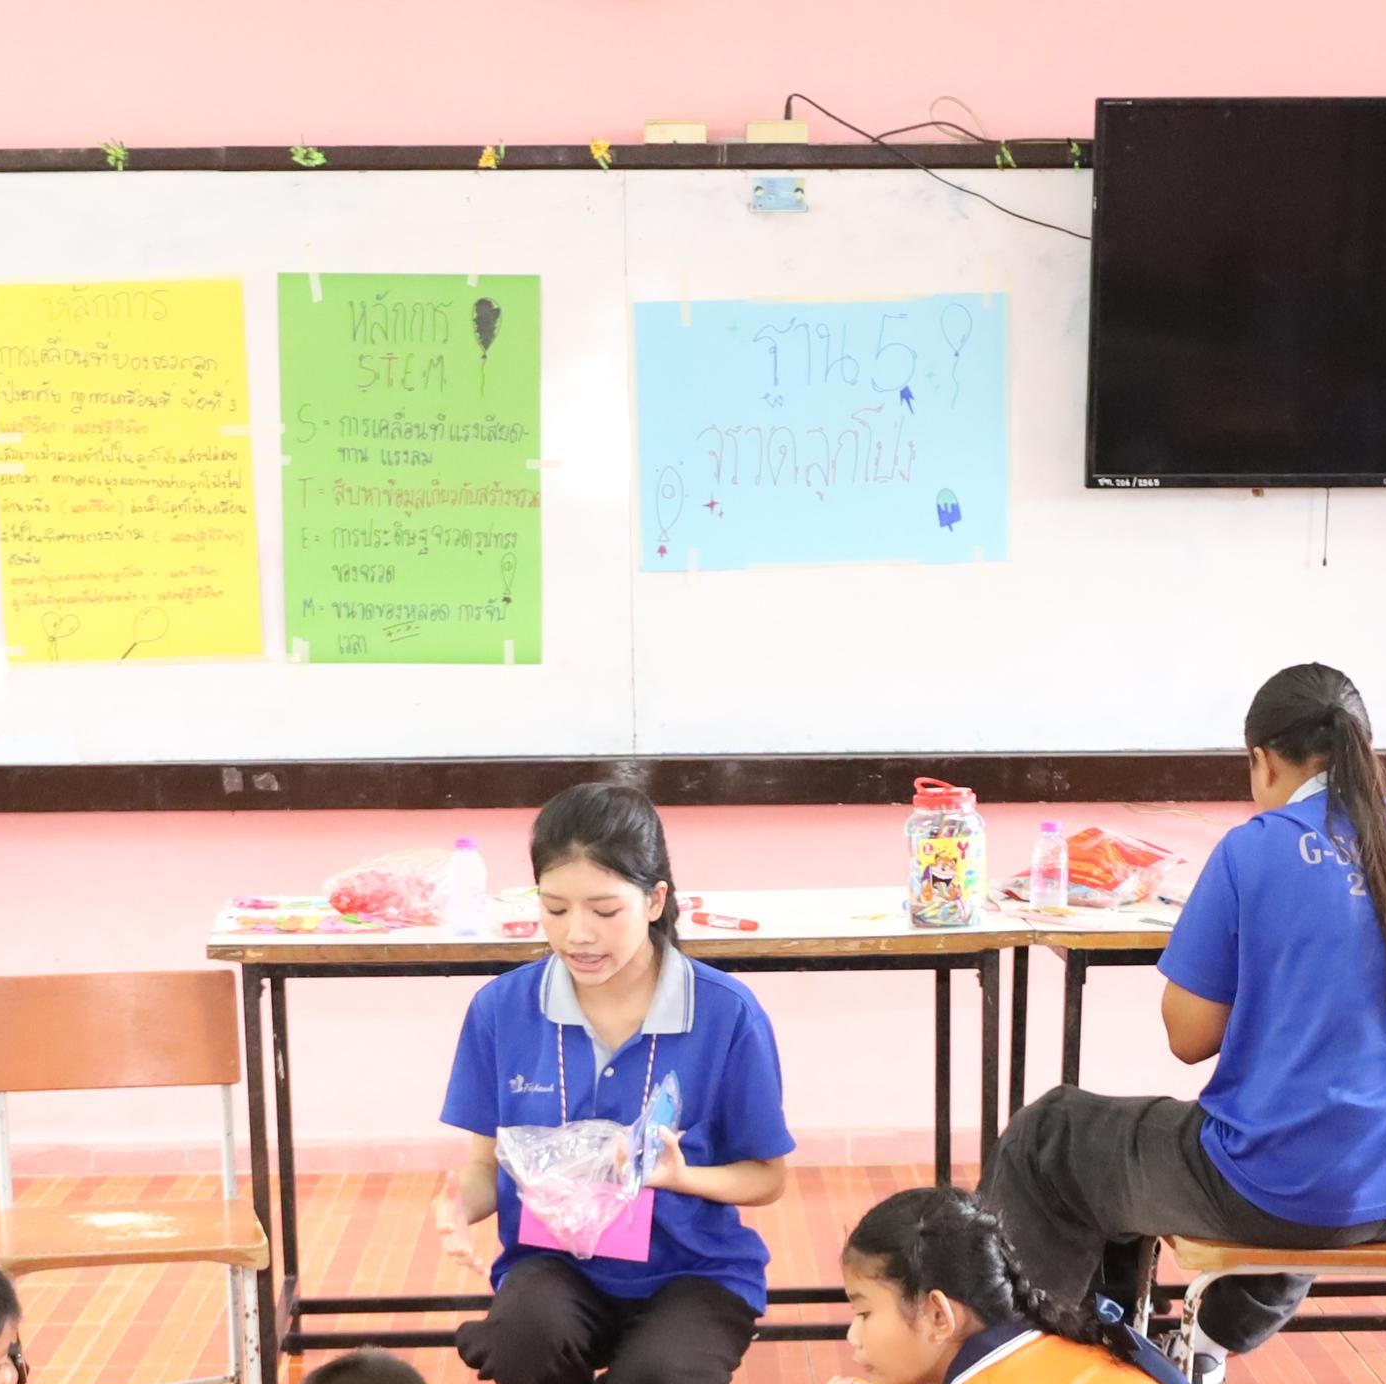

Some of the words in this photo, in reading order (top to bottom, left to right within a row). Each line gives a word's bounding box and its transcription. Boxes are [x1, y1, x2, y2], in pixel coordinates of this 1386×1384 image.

[44, 285, 169, 322] หลักการ
[348, 289, 455, 346] หลักการ
[356, 352, 448, 392] STEM
[870, 312, 919, 393] 5
[296, 402, 318, 444] S
[298, 477, 314, 509] T
